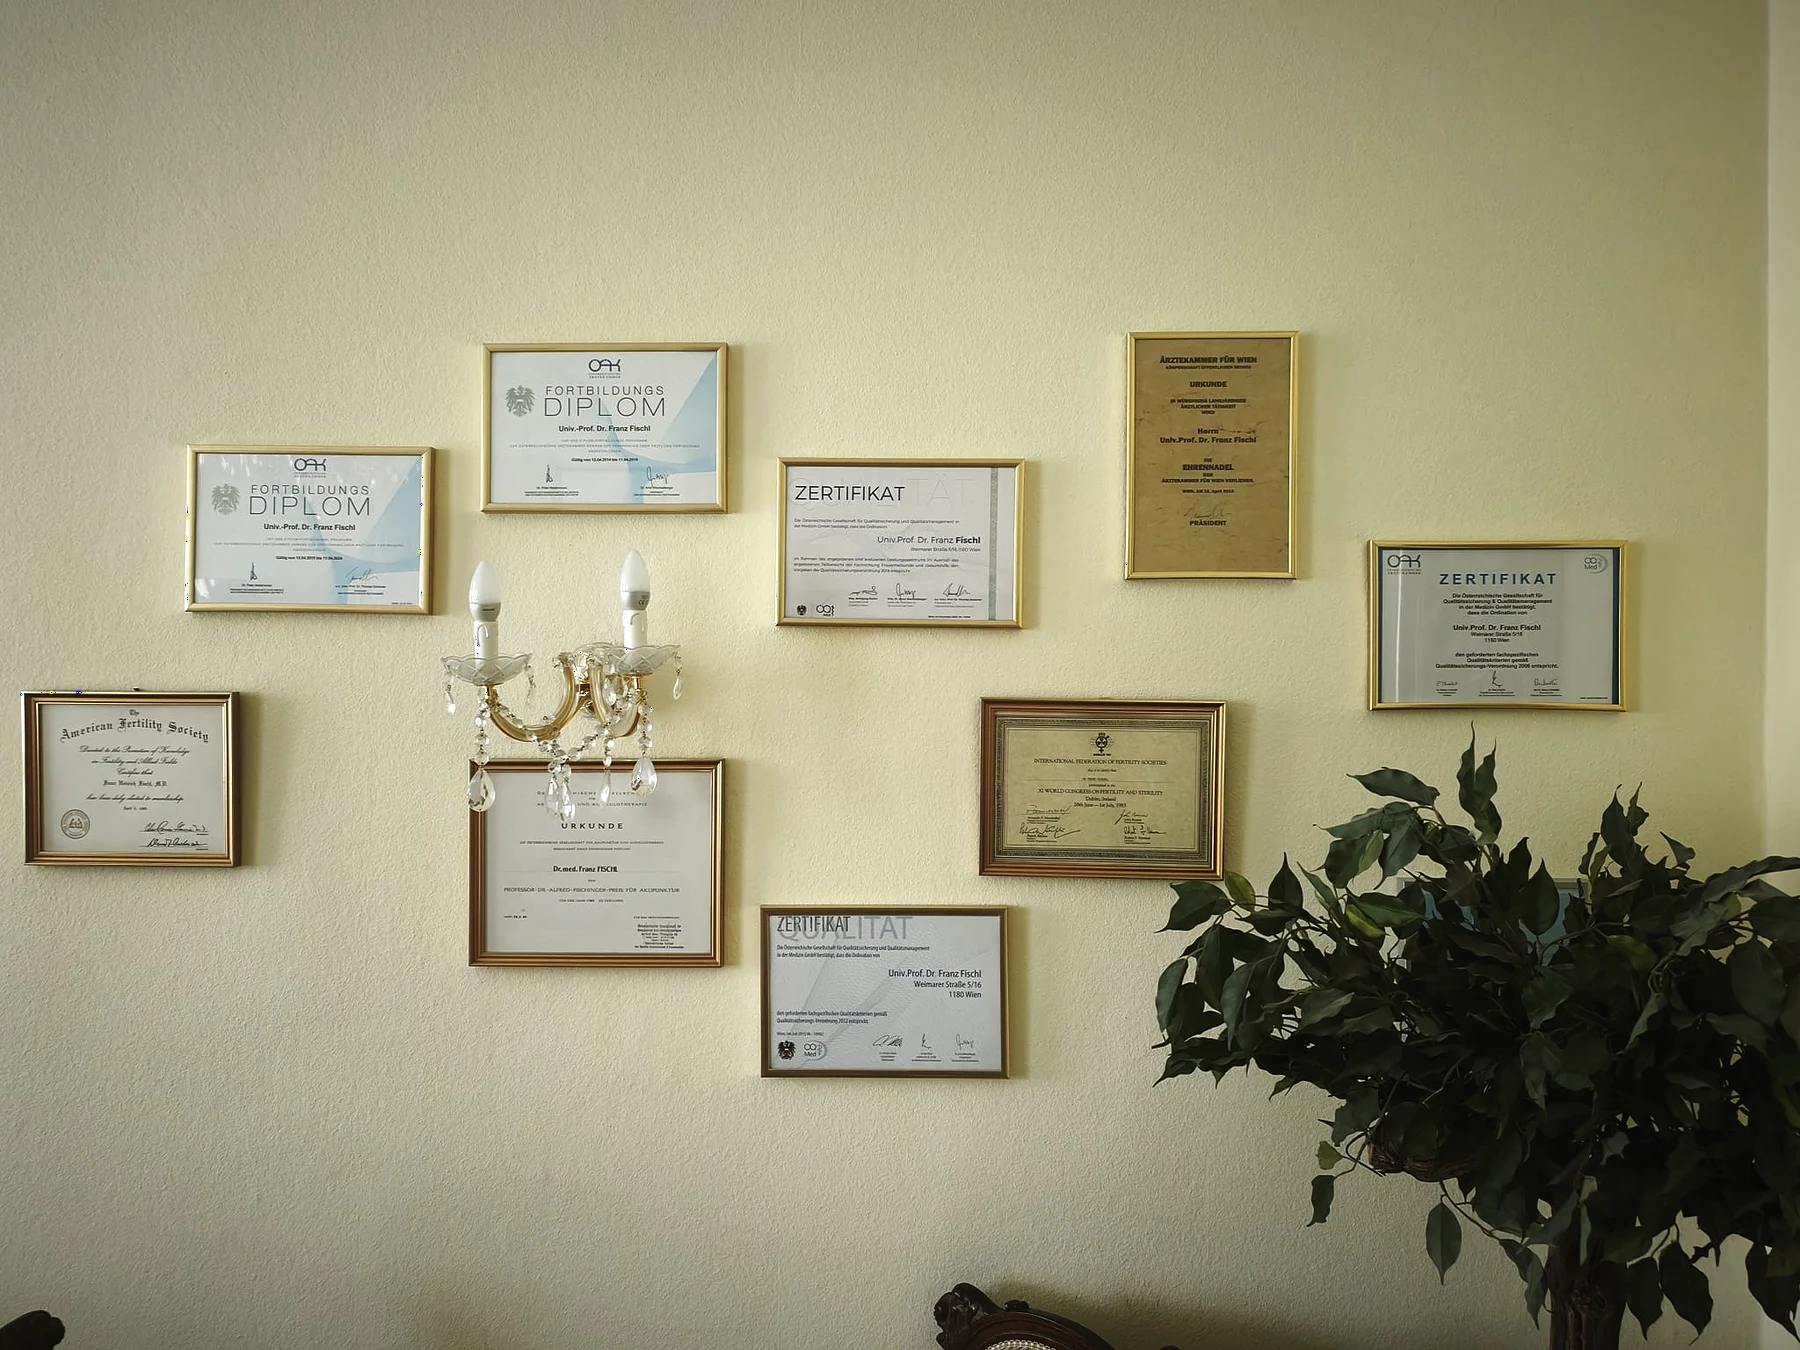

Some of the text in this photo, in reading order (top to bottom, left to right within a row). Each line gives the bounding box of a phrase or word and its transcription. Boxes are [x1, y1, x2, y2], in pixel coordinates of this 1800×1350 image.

[1160, 355, 1257, 363] ÄRZTEKAMMER FÜR WIEN
[1190, 380, 1227, 388] URKUNDE
[546, 386, 664, 395] FORTBILDUNGS
[545, 397, 664, 417] DIPLOM
[1198, 436, 1210, 444] Dr.
[1211, 436, 1233, 444] Franz
[1234, 436, 1257, 444] Fischl
[251, 484, 369, 495] FORTBILDUNGS
[795, 485, 905, 501] ZERTIFIKAT
[249, 496, 370, 516] DIPLOM
[301, 523, 312, 531] Dr.
[313, 523, 333, 531] Franz
[335, 523, 356, 531] Fischl
[1190, 519, 1227, 527] PRÄSIDENT
[931, 535, 954, 544] Franz
[956, 535, 981, 544] Fischl
[1439, 573, 1556, 585] ZERTIFIKAT
[129, 709, 140, 717] The
[60, 718, 209, 743] American Fertility Society
[777, 916, 851, 932] ZERTIFIKAT
[938, 968, 959, 977] Franz
[960, 968, 982, 977] Fischl
[913, 980, 981, 988] Weimarer Straße 5/16
[949, 990, 982, 998] 1180 Wien
